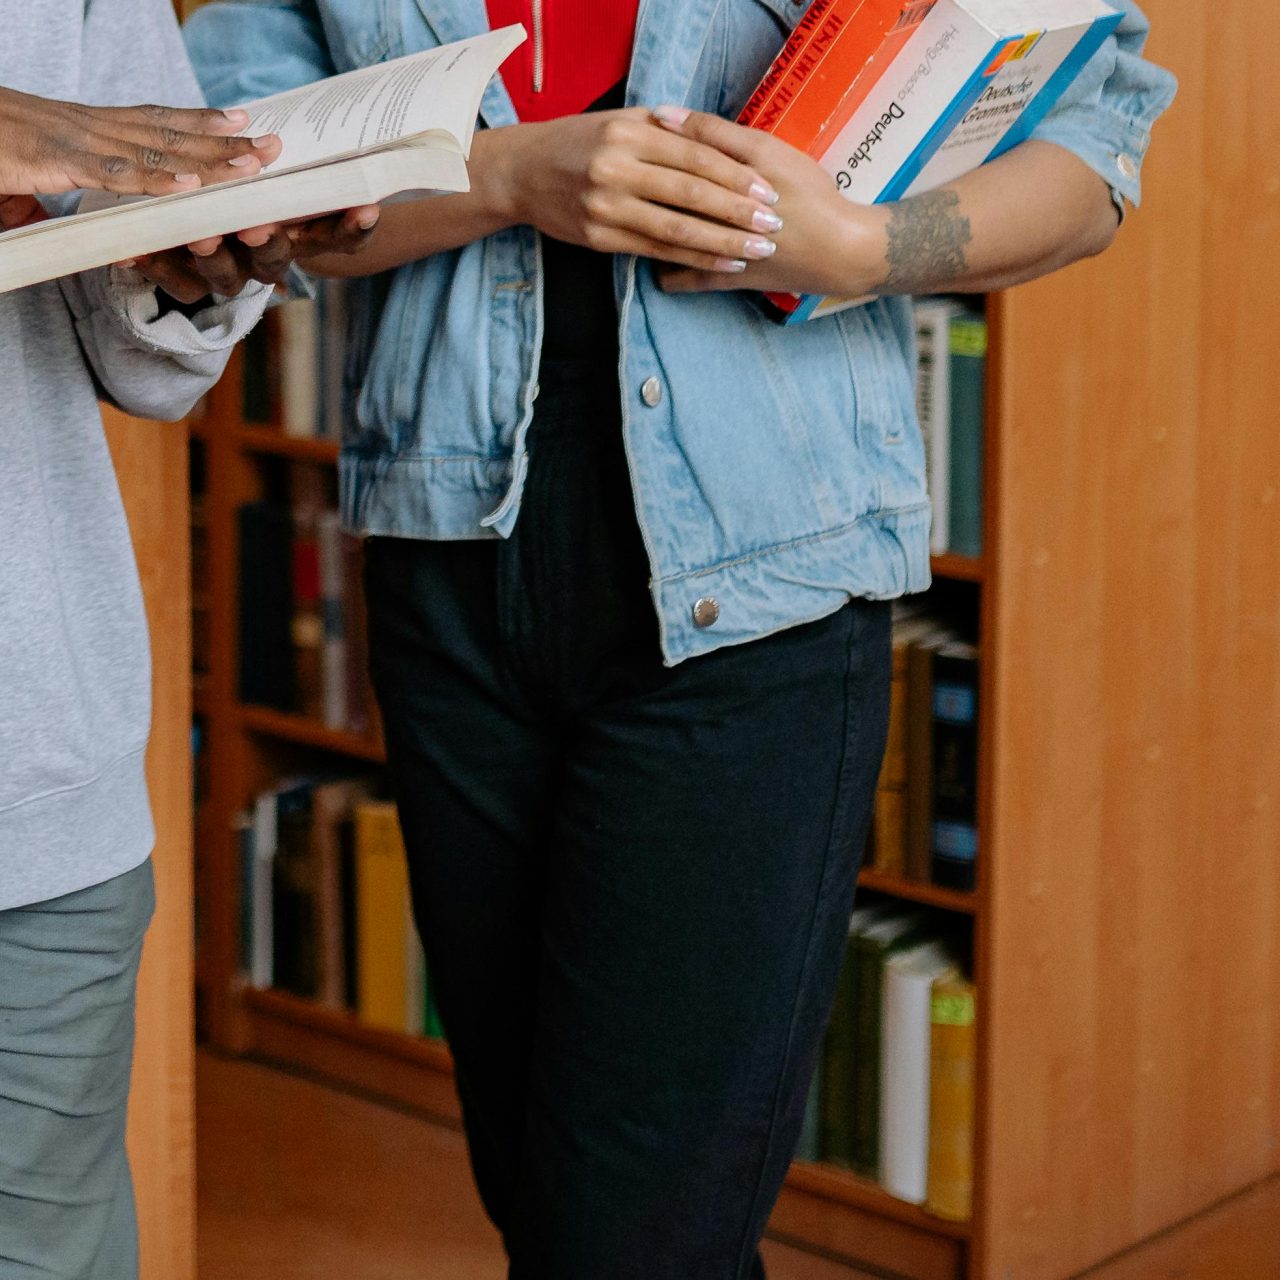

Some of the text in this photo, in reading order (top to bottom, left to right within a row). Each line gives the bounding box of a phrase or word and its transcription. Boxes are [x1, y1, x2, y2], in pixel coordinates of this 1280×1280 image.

[794, 13, 844, 83] DEUTSCH
[978, 76, 1033, 103] Deutsche
[848, 102, 905, 169] Deutsche
[836, 171, 852, 191] G
